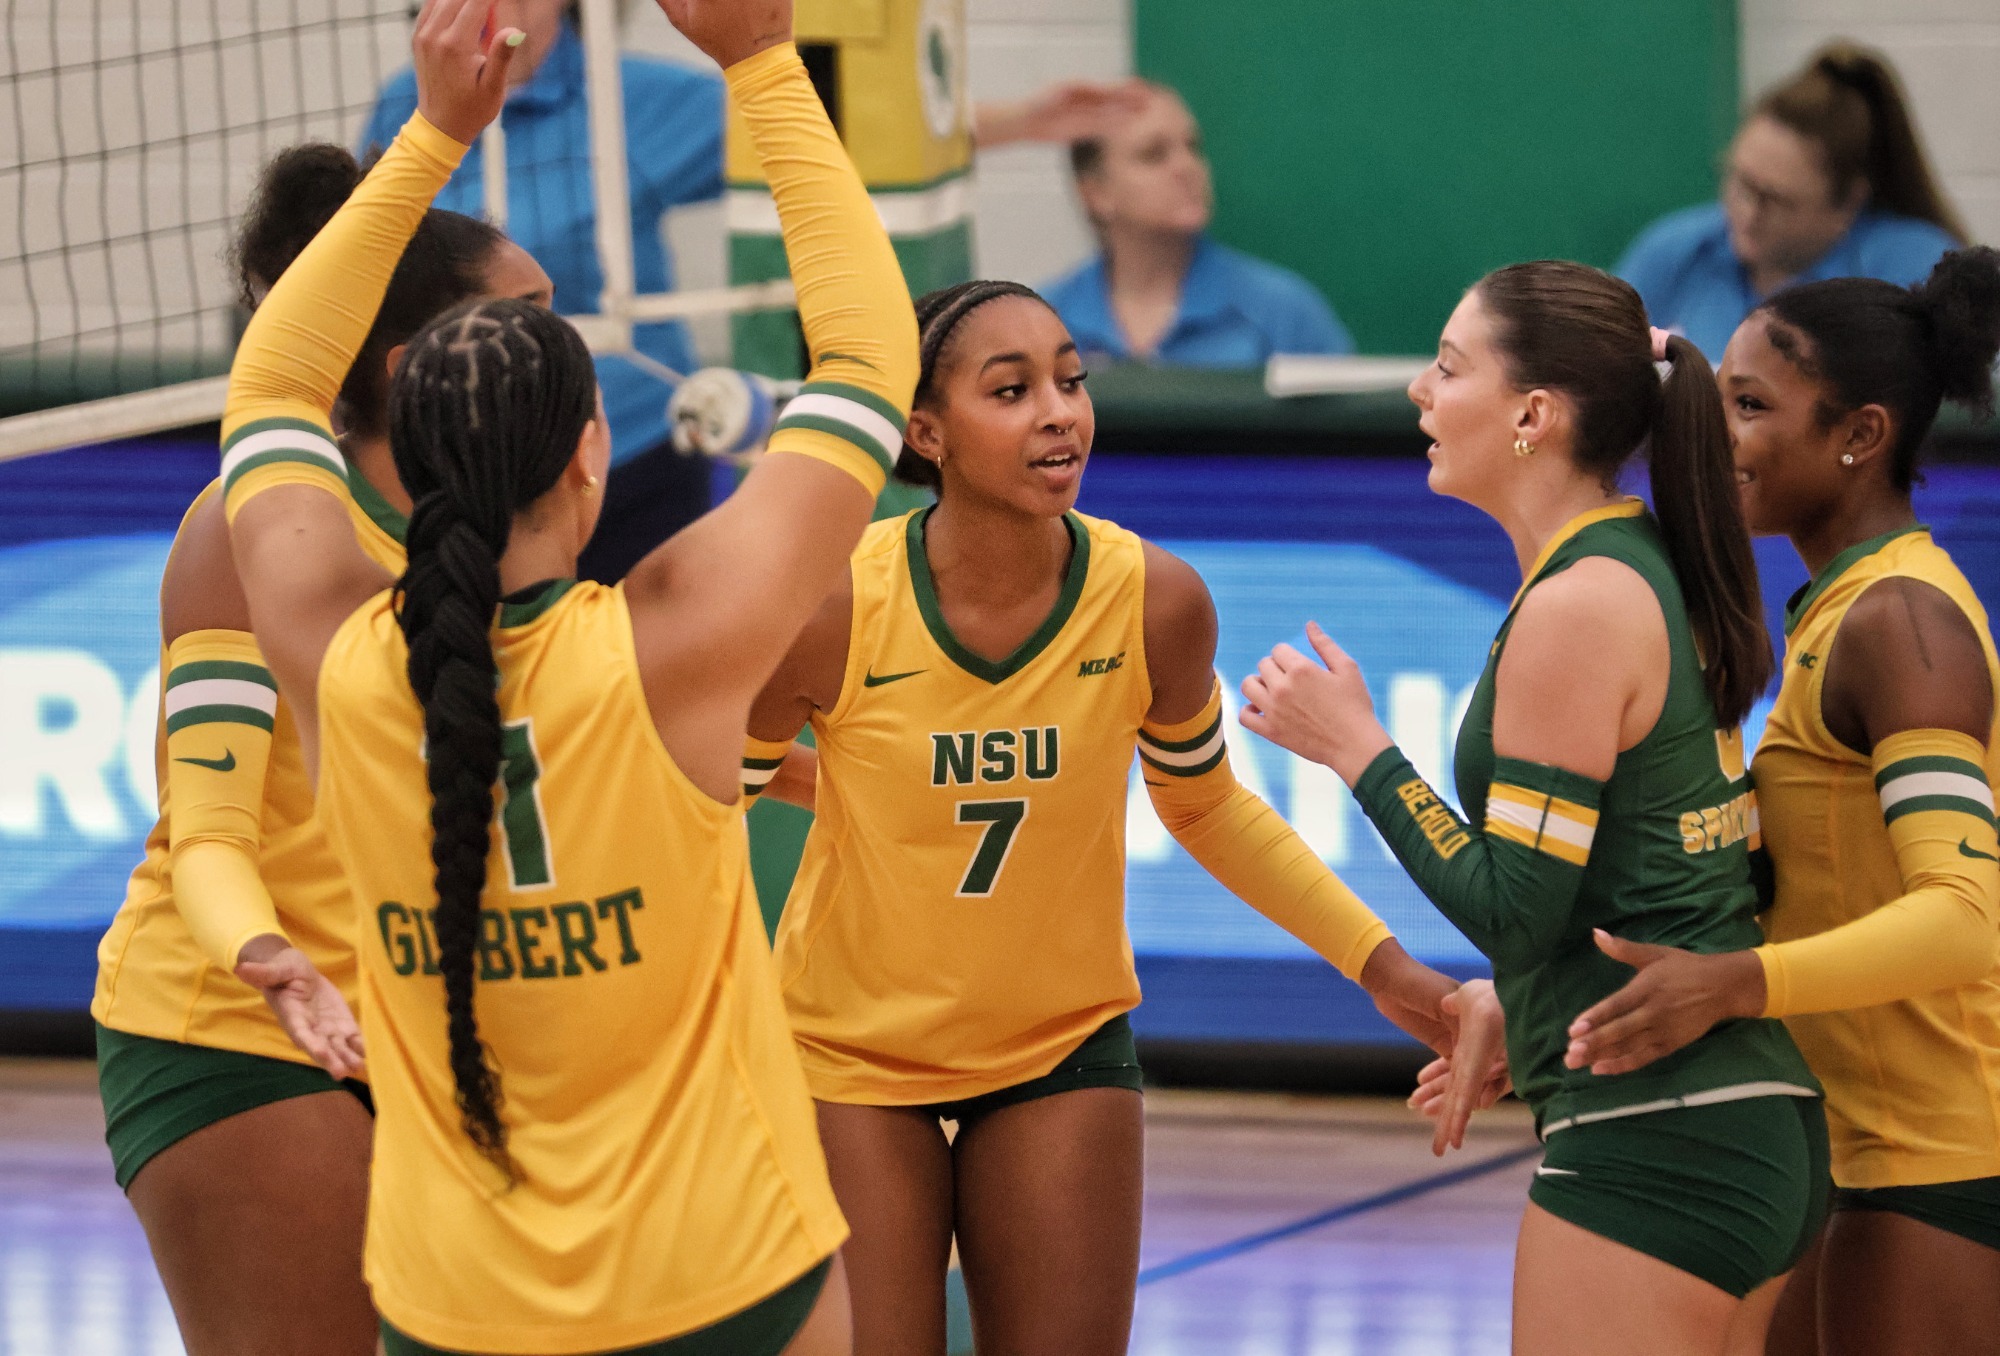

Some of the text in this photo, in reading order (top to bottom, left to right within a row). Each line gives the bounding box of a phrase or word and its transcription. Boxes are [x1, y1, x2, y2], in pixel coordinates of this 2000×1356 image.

[1077, 651, 1126, 678] MEAC
[930, 725, 1060, 787] NSU
[955, 797, 1029, 897] 7
[1397, 778, 1471, 859] BEHOLD
[377, 886, 644, 981] GIBERT
